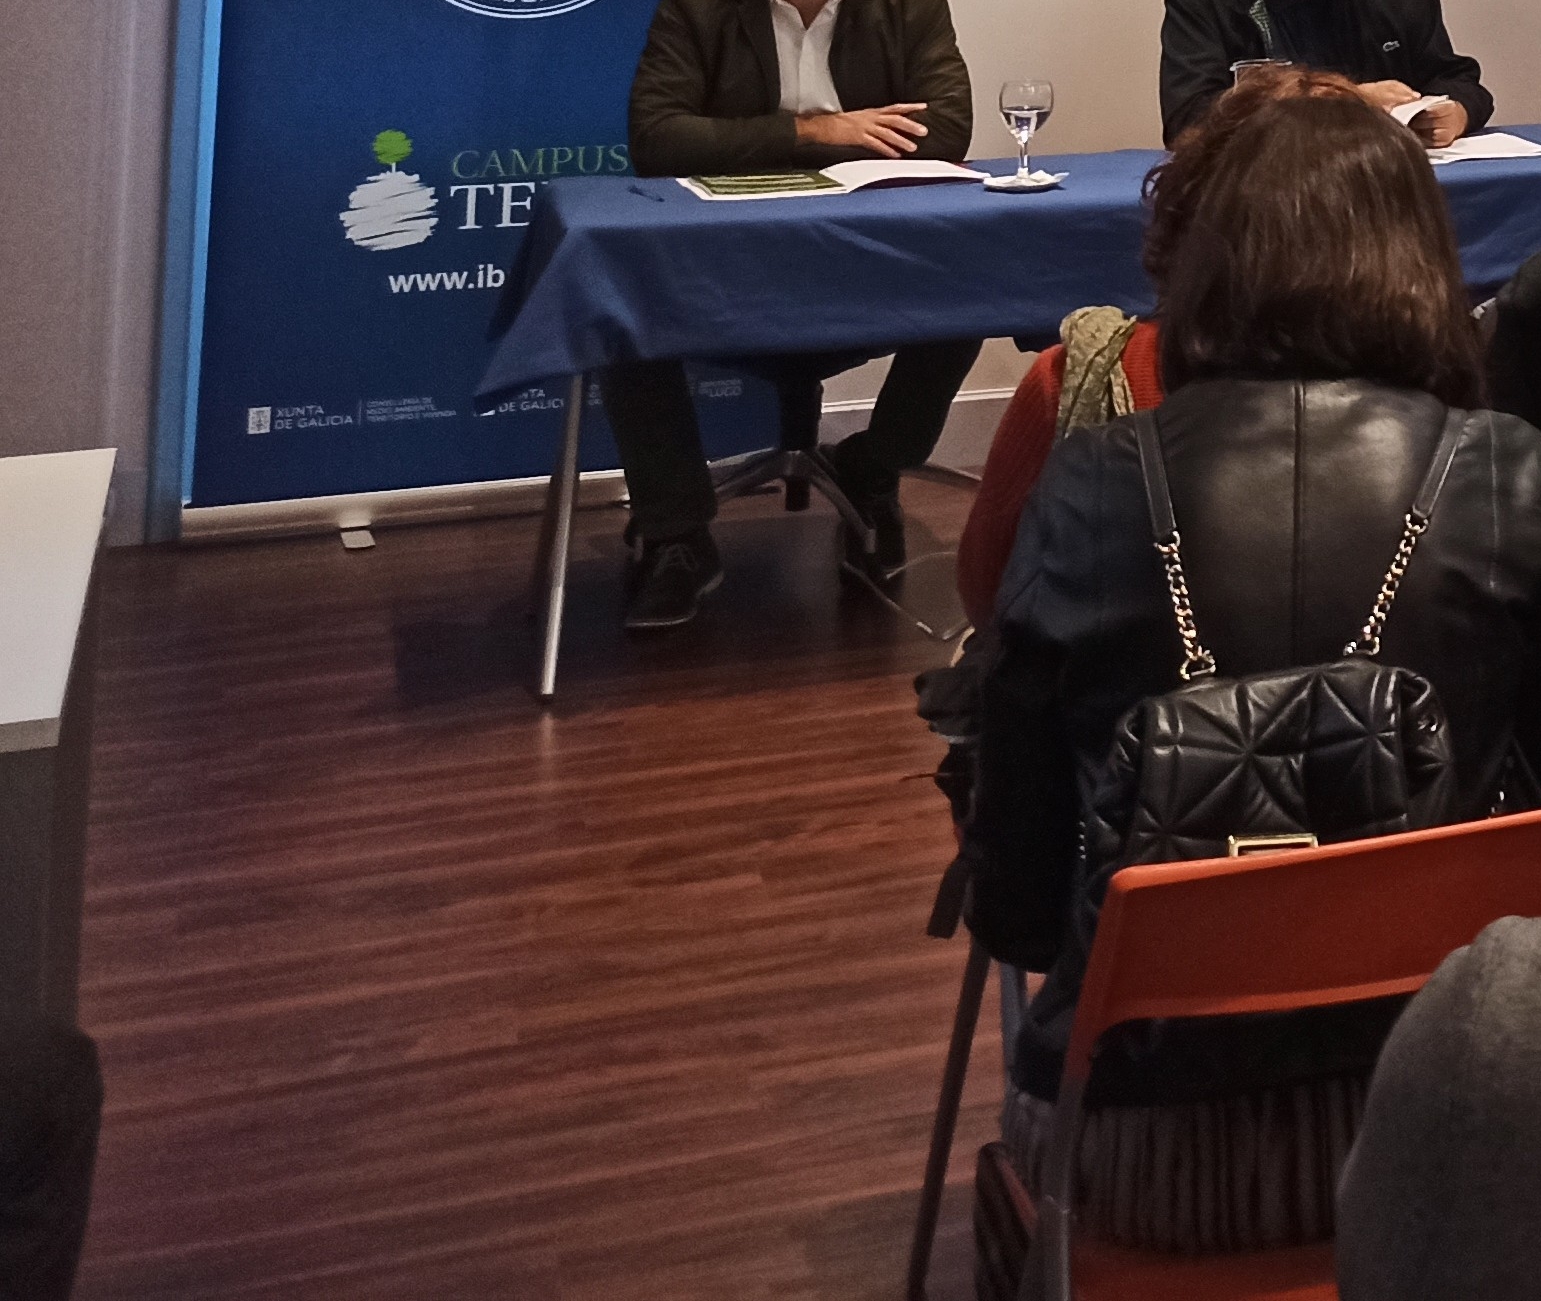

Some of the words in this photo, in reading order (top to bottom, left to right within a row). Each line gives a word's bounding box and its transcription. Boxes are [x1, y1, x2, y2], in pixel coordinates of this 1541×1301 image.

[452, 144, 629, 179] CAMPUS
[450, 181, 549, 230] TE
[276, 405, 325, 418] XUNTA
[499, 401, 516, 413] DE
[274, 418, 293, 431] DE
[299, 415, 353, 429] GALICIA
